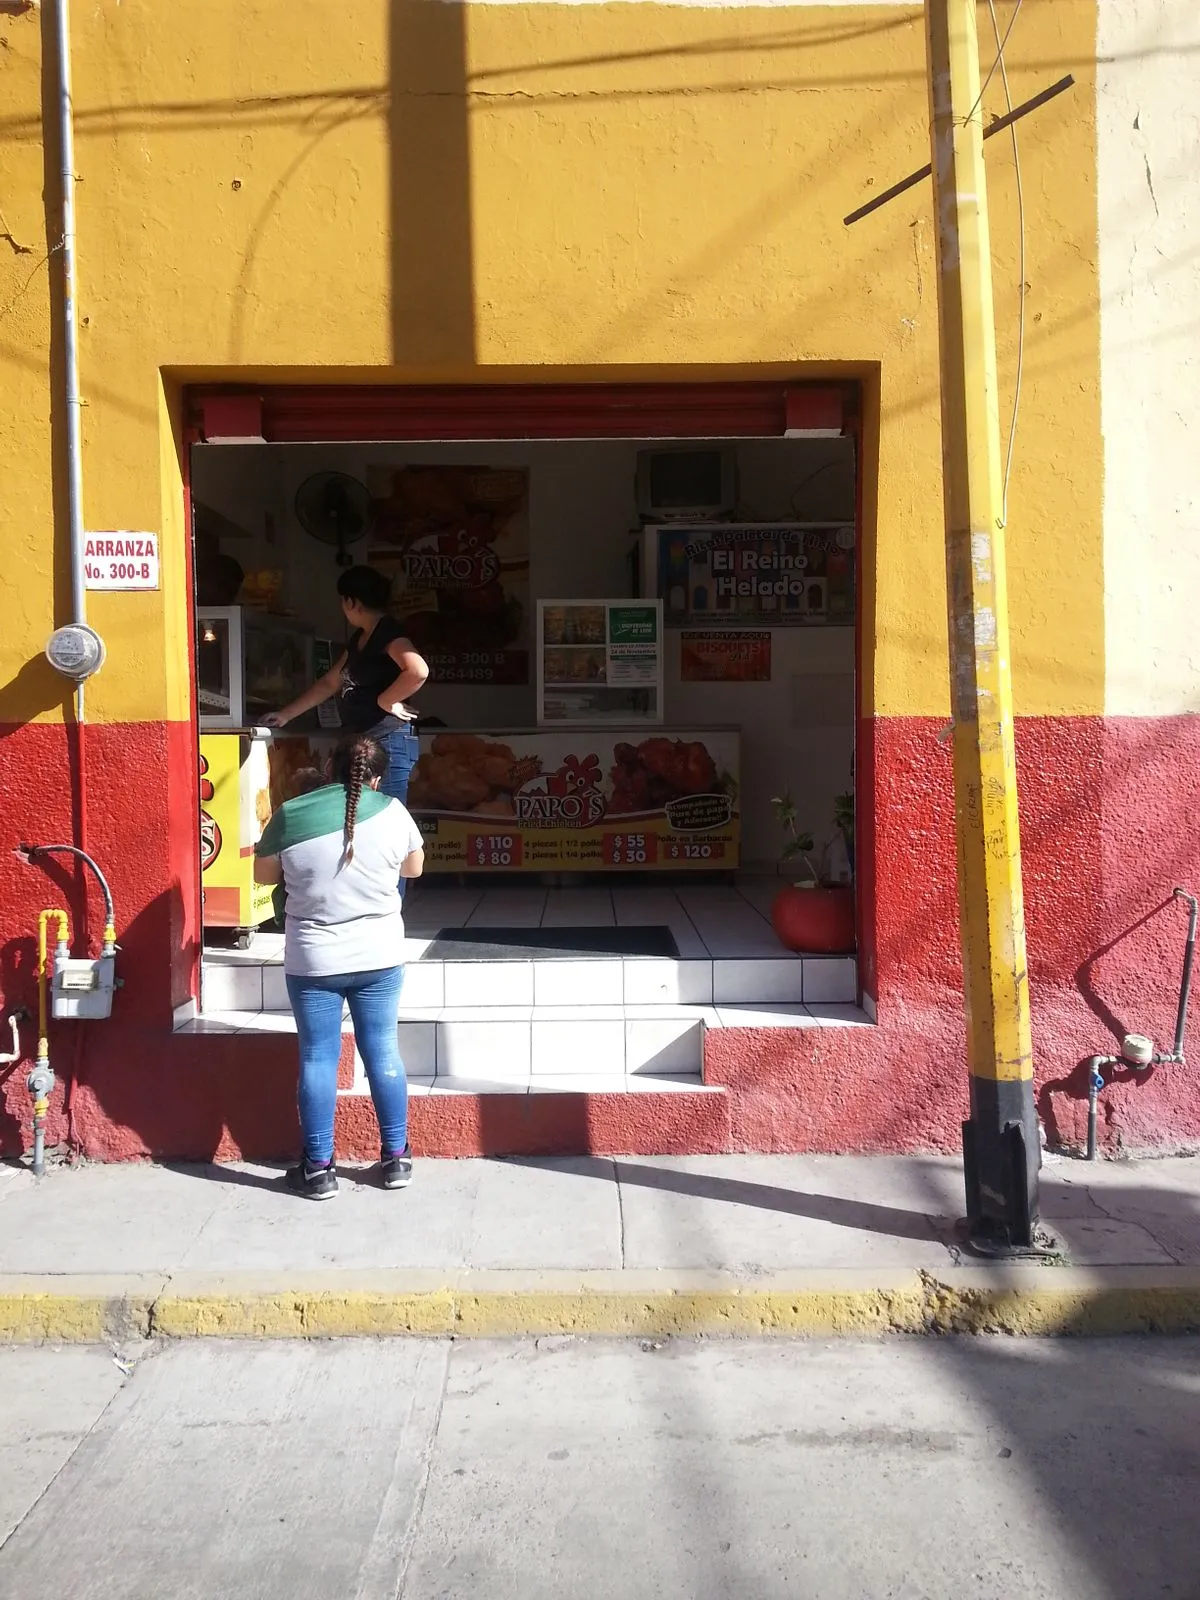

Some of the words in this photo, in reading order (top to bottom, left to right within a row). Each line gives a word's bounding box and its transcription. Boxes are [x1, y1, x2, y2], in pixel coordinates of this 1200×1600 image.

[85, 540, 154, 556] ARRANZA
[713, 550, 734, 570] El
[741, 550, 808, 570] Reino
[84, 563, 104, 579] No.
[109, 563, 150, 579] 300-B
[718, 575, 804, 596] Helado
[461, 652, 489, 664] 300
[475, 836, 484, 850] $
[489, 836, 513, 849] 110
[613, 835, 621, 848] $
[627, 835, 646, 848] 55
[612, 849, 621, 862] $
[626, 850, 647, 863] 30
[671, 844, 680, 858] $
[683, 845, 712, 858] 120
[478, 852, 486, 865] $
[490, 853, 512, 865] 80
